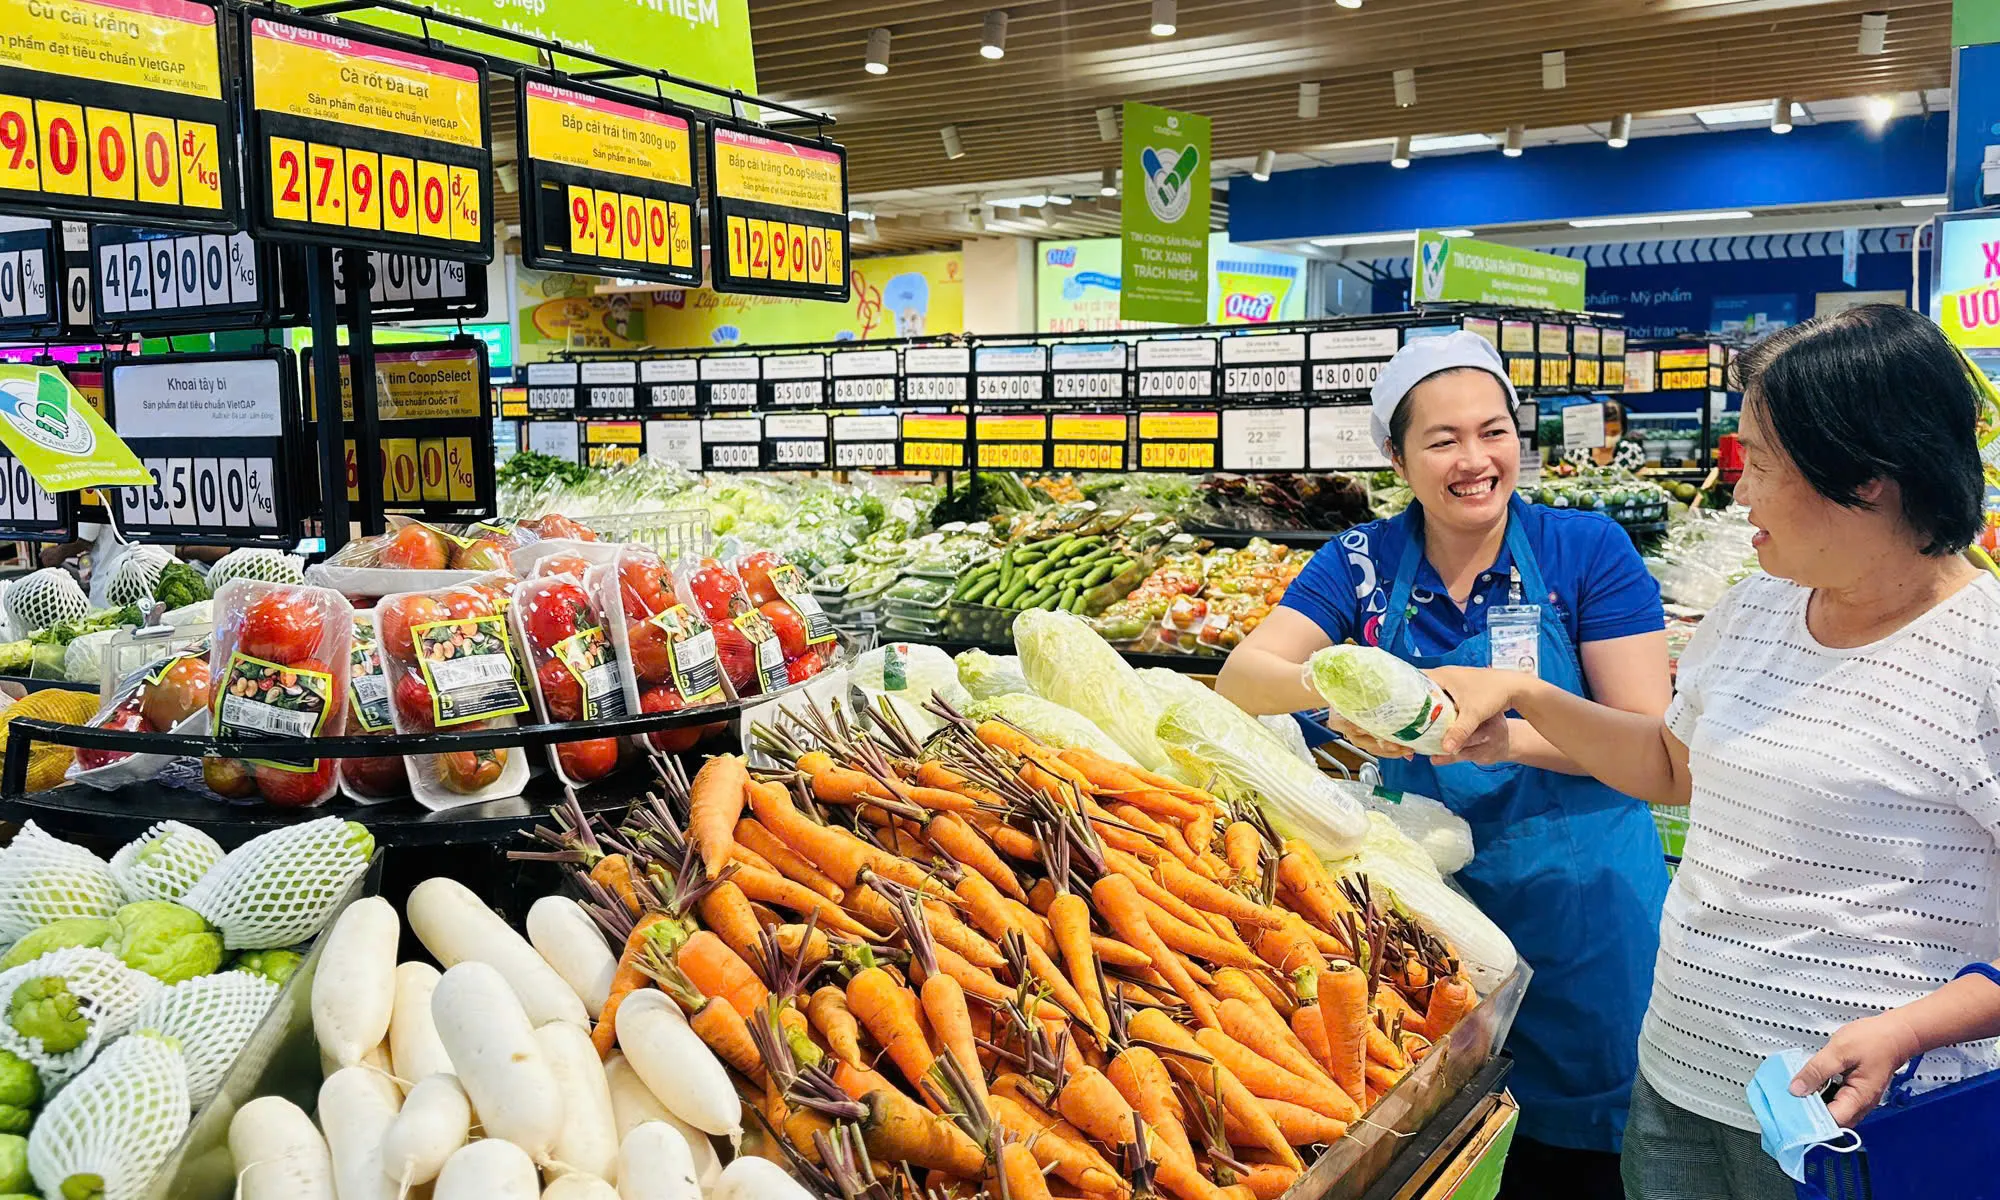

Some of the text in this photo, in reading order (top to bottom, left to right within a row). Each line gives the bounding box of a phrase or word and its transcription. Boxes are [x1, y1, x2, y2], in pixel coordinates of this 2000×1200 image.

[9, 35, 45, 51] phẩm
[49, 42, 69, 57] đạt
[72, 46, 96, 60] tiêu
[99, 50, 136, 67] chuẩn
[138, 56, 185, 74] VietGAP
[340, 67, 359, 84] Cà
[363, 71, 382, 89] rốt
[308, 92, 327, 106] Sản
[329, 98, 356, 112] phẩm
[358, 103, 373, 115] đạt
[375, 105, 392, 118] tiêu
[395, 109, 422, 123] chuẩn
[423, 115, 458, 130] VietGAP
[562, 113, 583, 133] Bắp
[585, 120, 601, 134] cải
[603, 123, 620, 138] trái
[640, 132, 662, 149] 300g
[664, 139, 677, 152] up
[182, 130, 218, 191] đ/kg
[607, 151, 626, 166] phẩm
[627, 157, 636, 165] an
[729, 153, 745, 169] Bắp
[747, 158, 759, 169] cải
[279, 150, 478, 226] 27.900 đ/kg
[573, 196, 665, 248] 9.900
[734, 227, 822, 273] 12.900
[1141, 247, 1192, 265] TICK XANH
[24, 259, 45, 298] đ/kg
[105, 242, 255, 297] 42.900 đ/kg
[1133, 263, 1198, 285] TRÁCH NHIỆM
[1654, 288, 1692, 304] phẩm
[167, 378, 197, 391] Khoai
[199, 377, 214, 394] tây
[408, 370, 472, 386] CoopSelect
[157, 398, 176, 411] phẩm
[204, 398, 225, 409] chuẩn
[227, 400, 256, 409] VietGAP
[405, 397, 427, 407] chuẩn
[427, 396, 448, 406] Quốc
[448, 395, 459, 406] Tế
[449, 448, 473, 488] đ/kg
[249, 471, 272, 513] đ/kg
